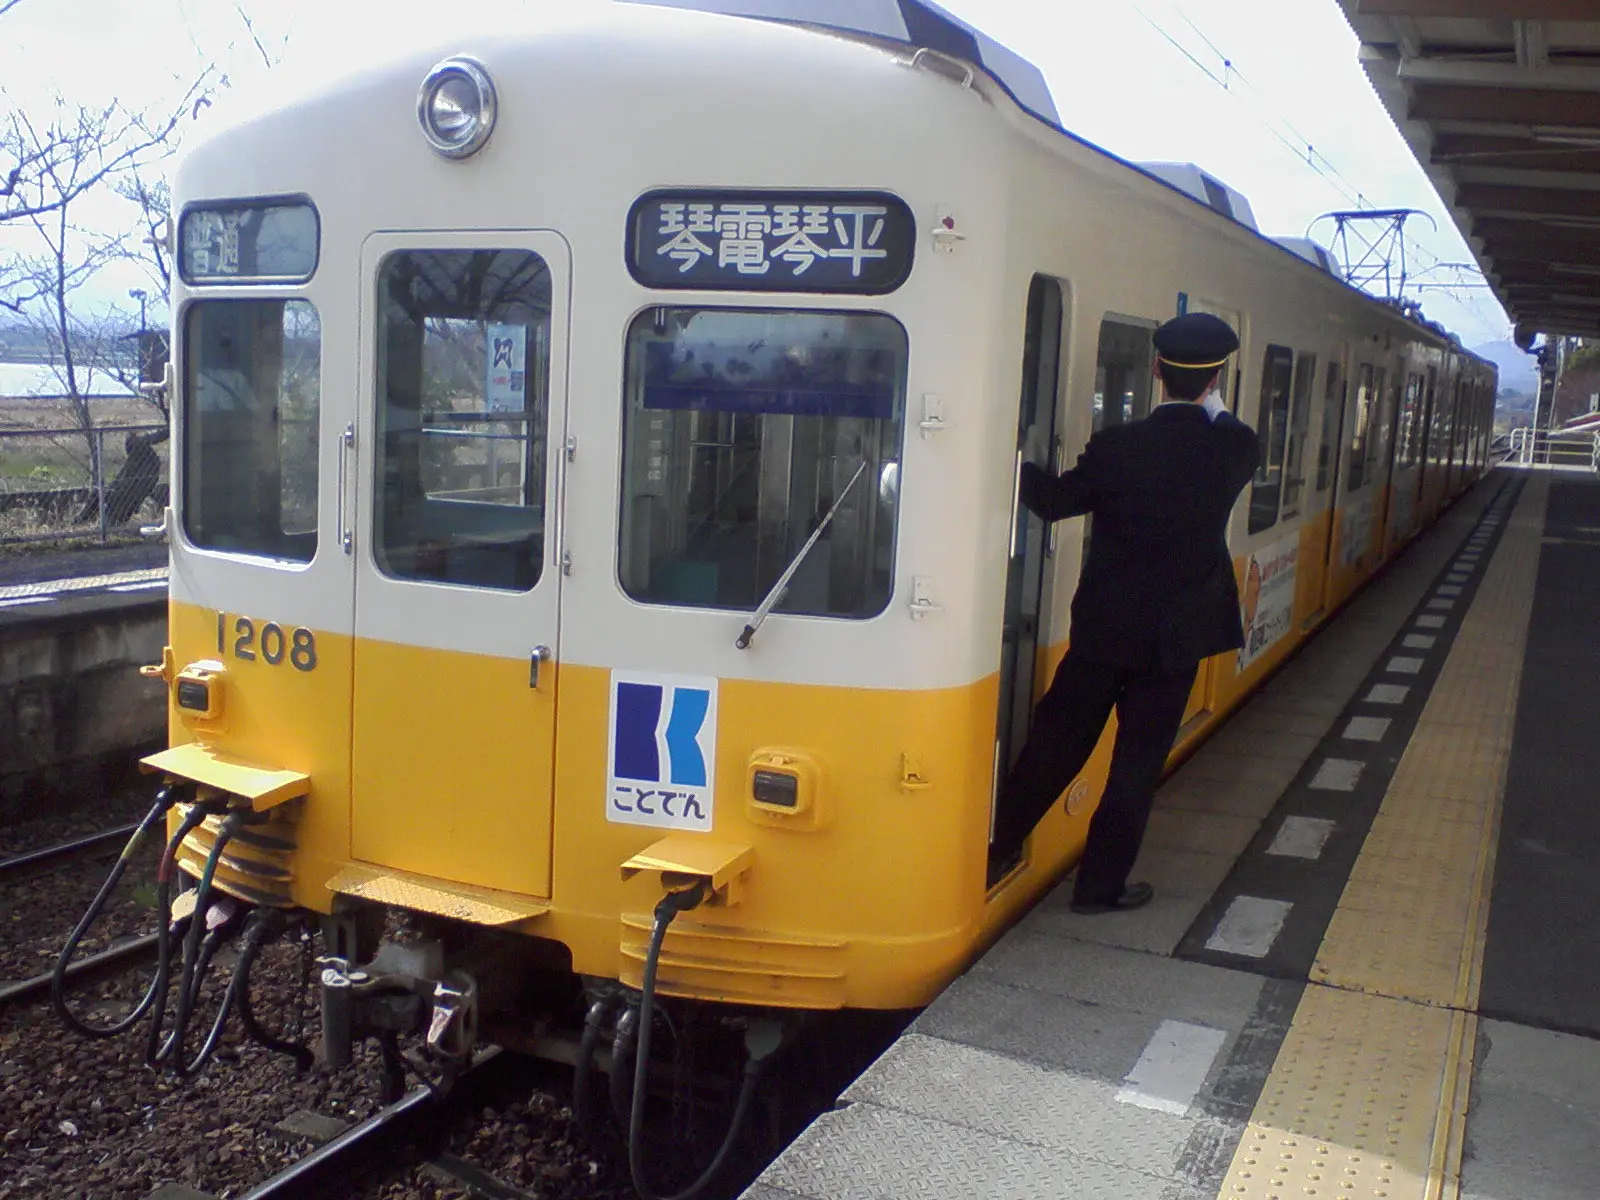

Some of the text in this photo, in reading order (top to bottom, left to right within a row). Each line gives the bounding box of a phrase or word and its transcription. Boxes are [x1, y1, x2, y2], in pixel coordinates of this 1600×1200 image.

[656, 203, 888, 277] 琴電琴平
[216, 610, 318, 672] 1208
[613, 786, 706, 820] ことでん
